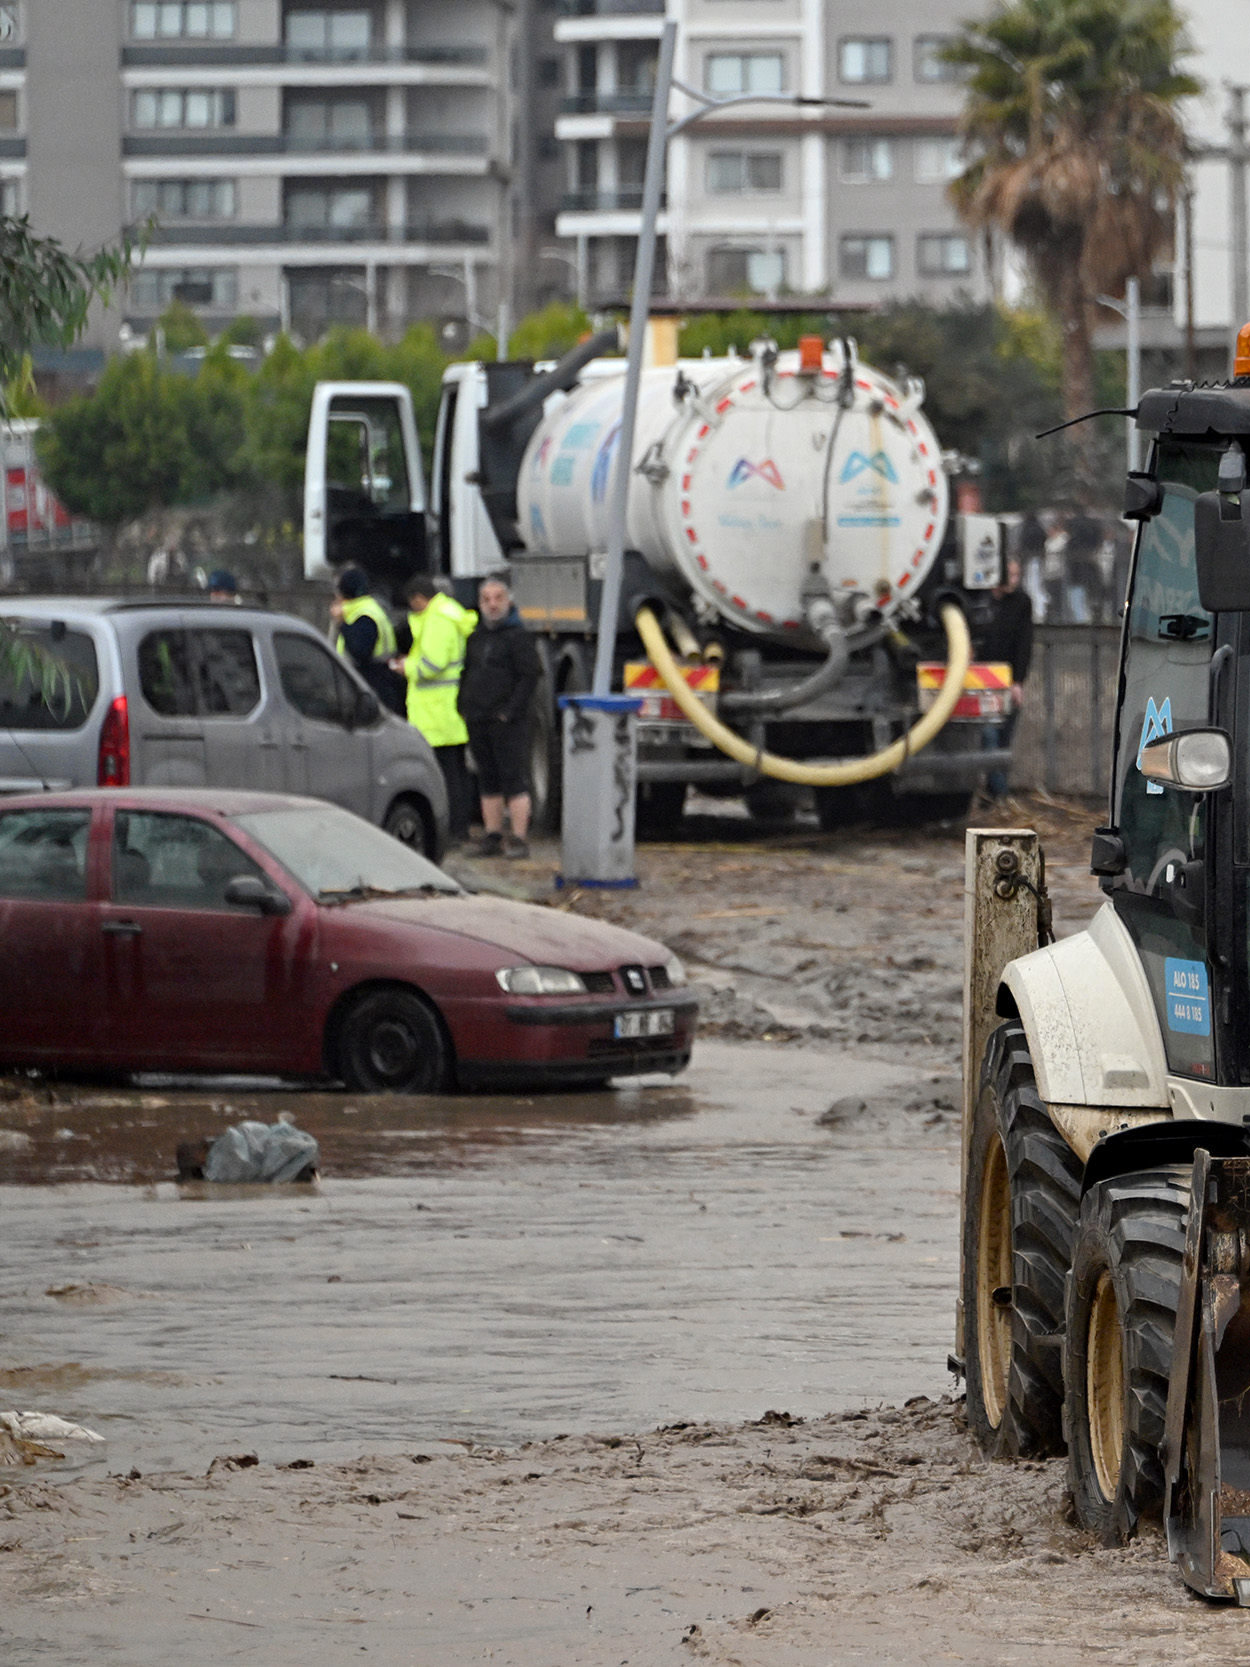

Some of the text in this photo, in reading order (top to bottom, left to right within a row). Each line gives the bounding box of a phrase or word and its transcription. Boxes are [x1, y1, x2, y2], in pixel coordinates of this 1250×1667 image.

[1174, 971, 1200, 990] ALO 185
[1175, 1004, 1202, 1022] 444 8 185
